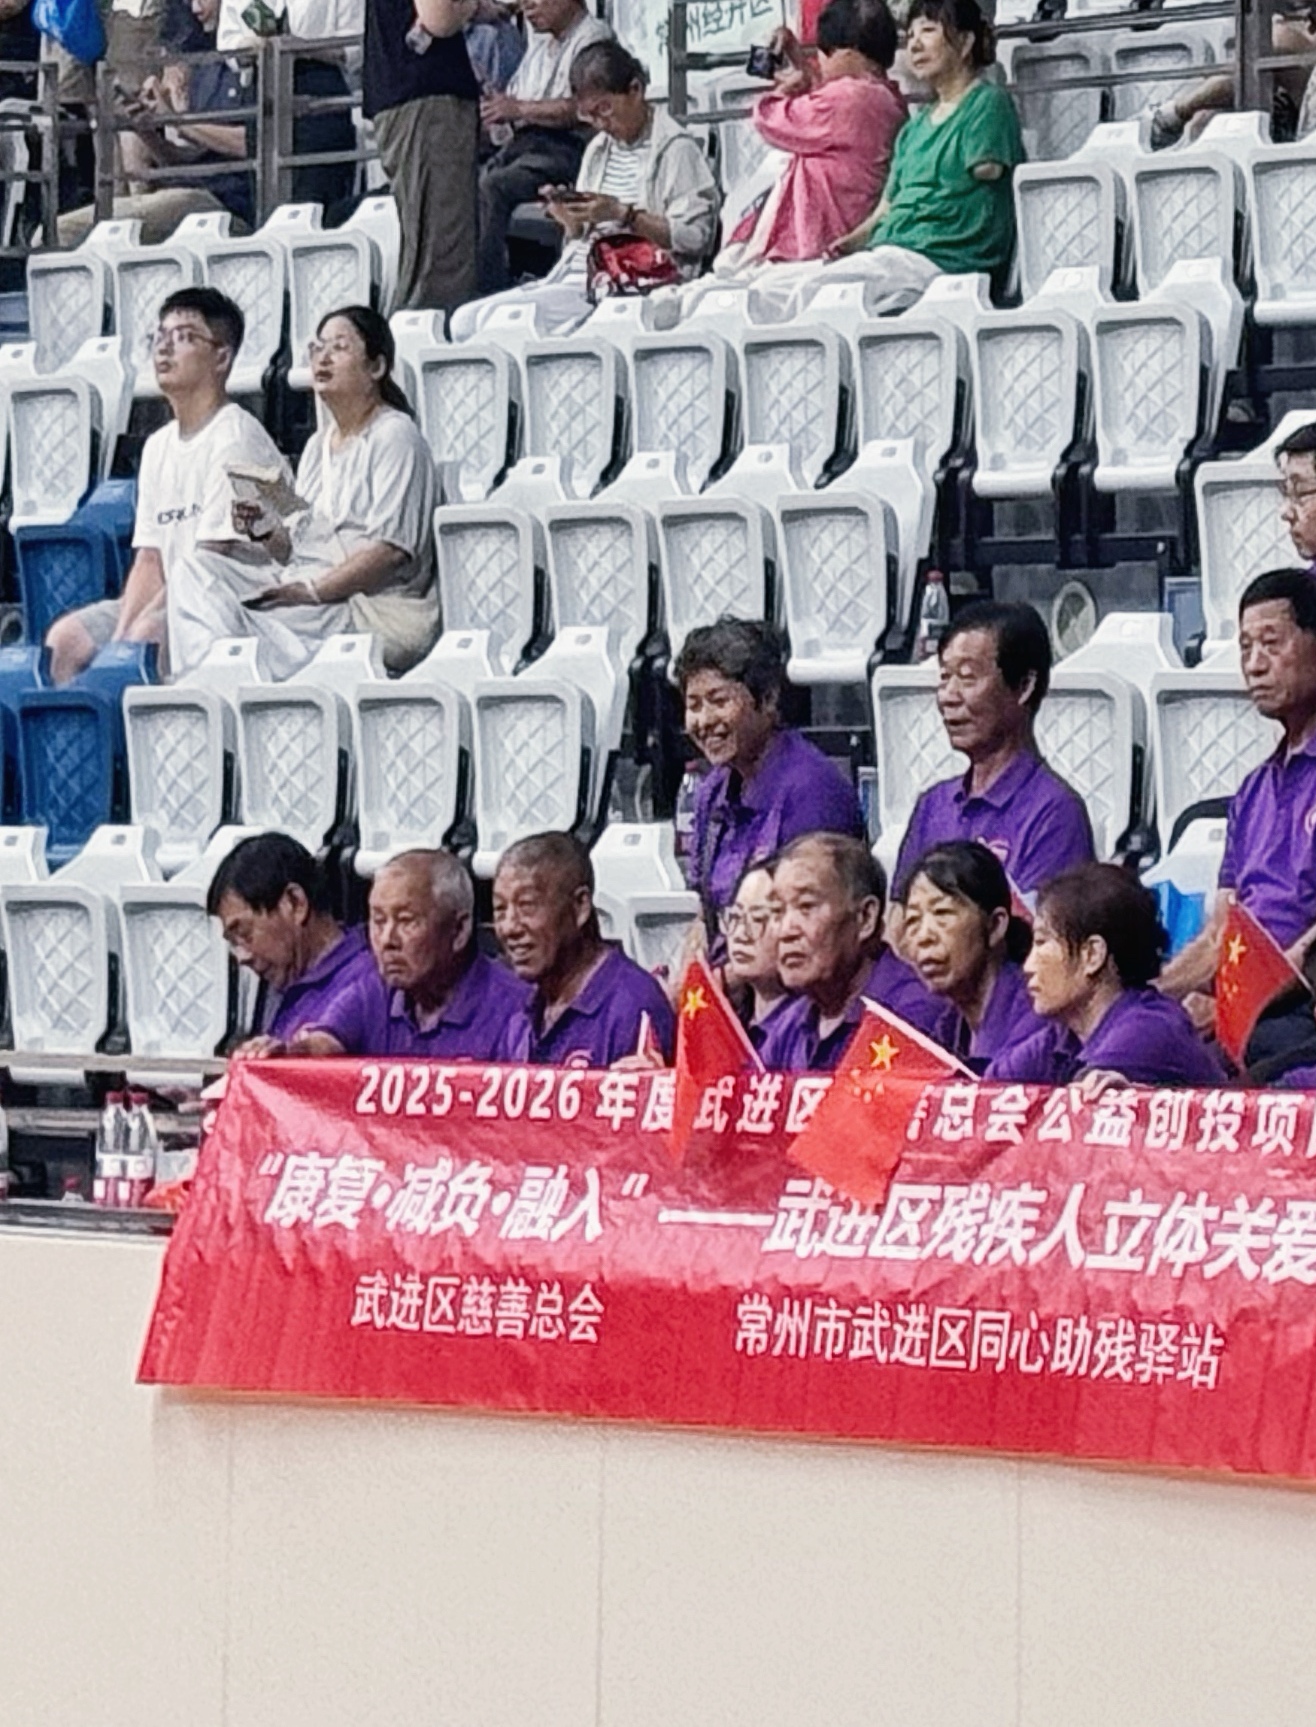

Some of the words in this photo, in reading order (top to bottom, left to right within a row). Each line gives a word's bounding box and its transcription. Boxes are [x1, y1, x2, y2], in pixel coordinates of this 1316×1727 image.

[351, 1271, 605, 1343] 武进区慈善总会
[735, 1294, 1225, 1389] 常州市武进区同心助残驿站
